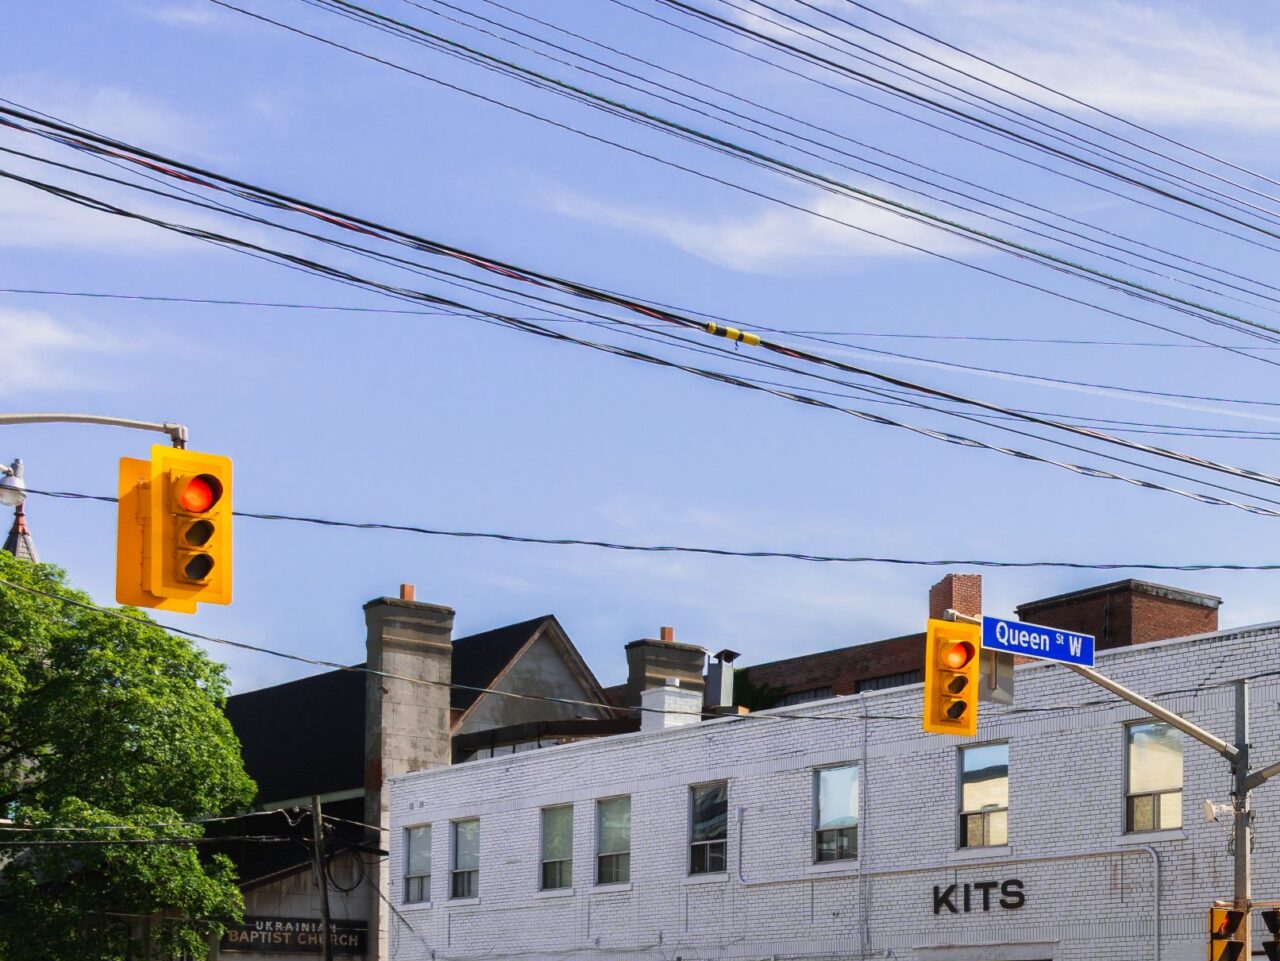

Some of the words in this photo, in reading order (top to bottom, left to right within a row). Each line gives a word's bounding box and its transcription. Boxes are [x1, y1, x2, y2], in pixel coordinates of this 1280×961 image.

[996, 621, 1050, 652] Queen
[1055, 633, 1064, 645] St
[1069, 635, 1083, 657] W
[933, 879, 1026, 915] KITS
[228, 929, 291, 944] BAPTIST
